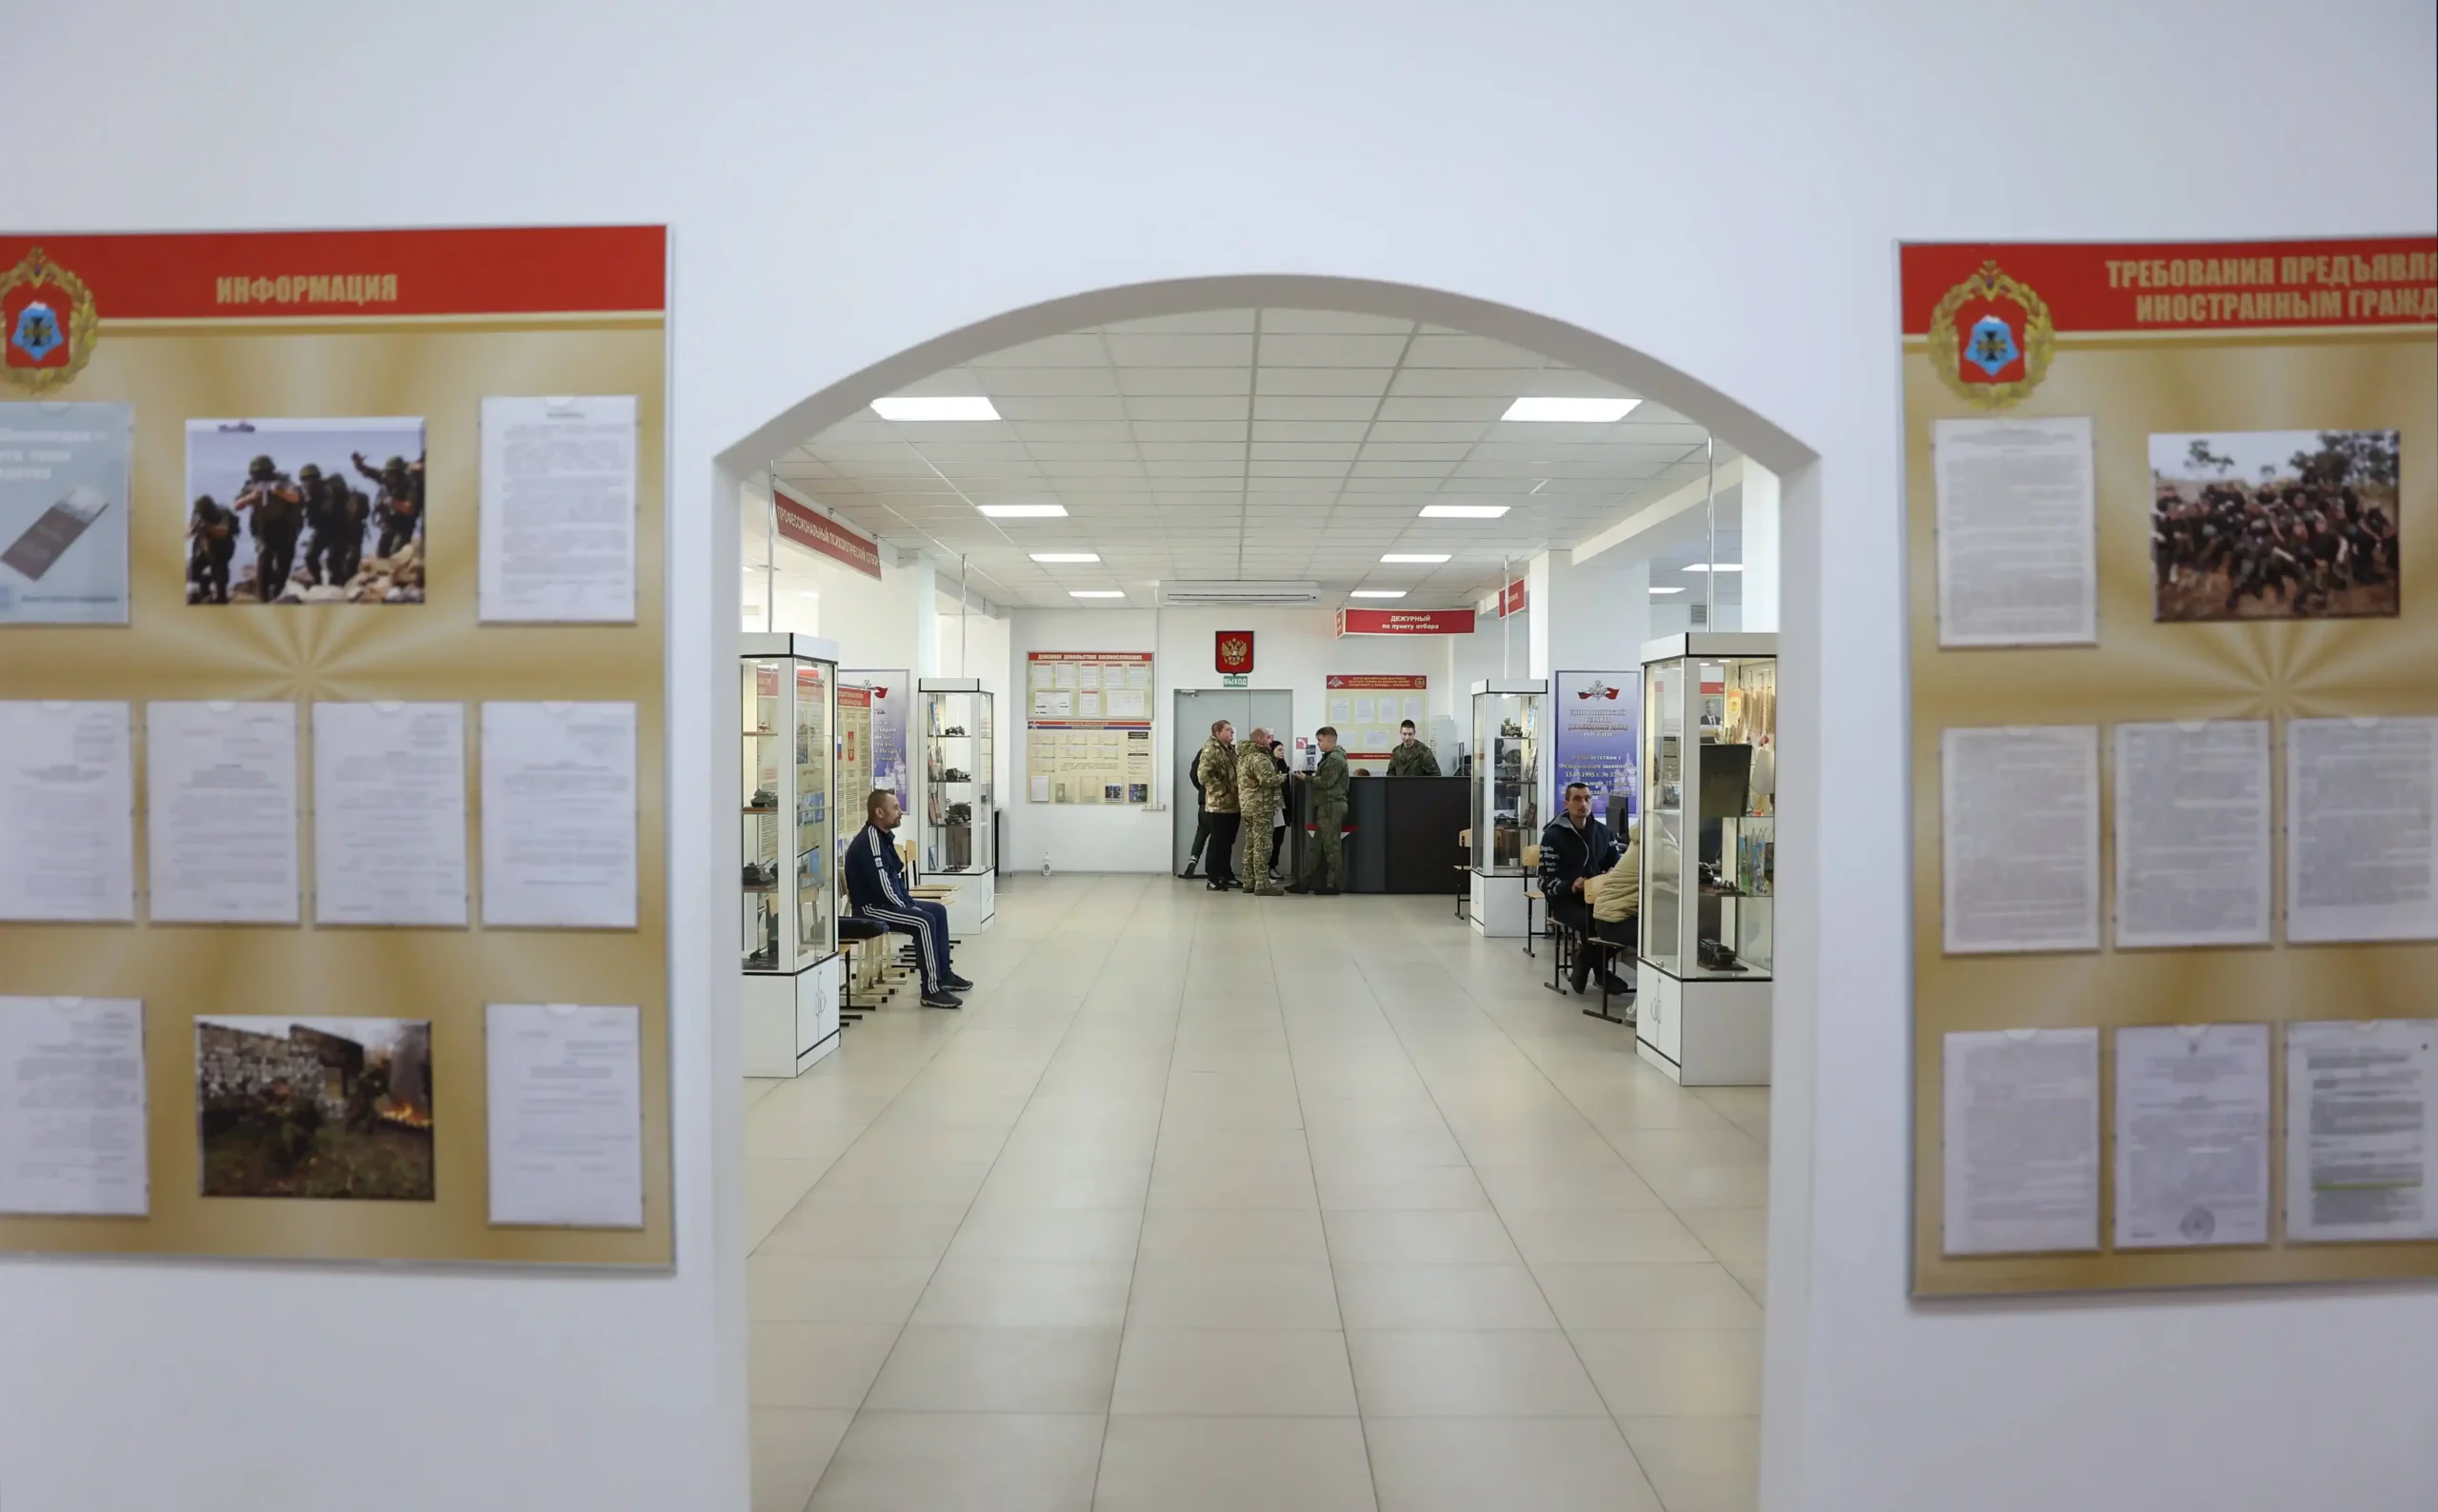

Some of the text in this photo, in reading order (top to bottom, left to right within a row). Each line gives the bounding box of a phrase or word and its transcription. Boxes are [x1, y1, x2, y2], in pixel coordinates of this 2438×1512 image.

[2106, 258, 2274, 288] ТРЕБОВАНИЯ
[216, 274, 397, 306] ИНФОРМАЦИЯ
[2135, 291, 2343, 323] ИНОСТРАННЫМ
